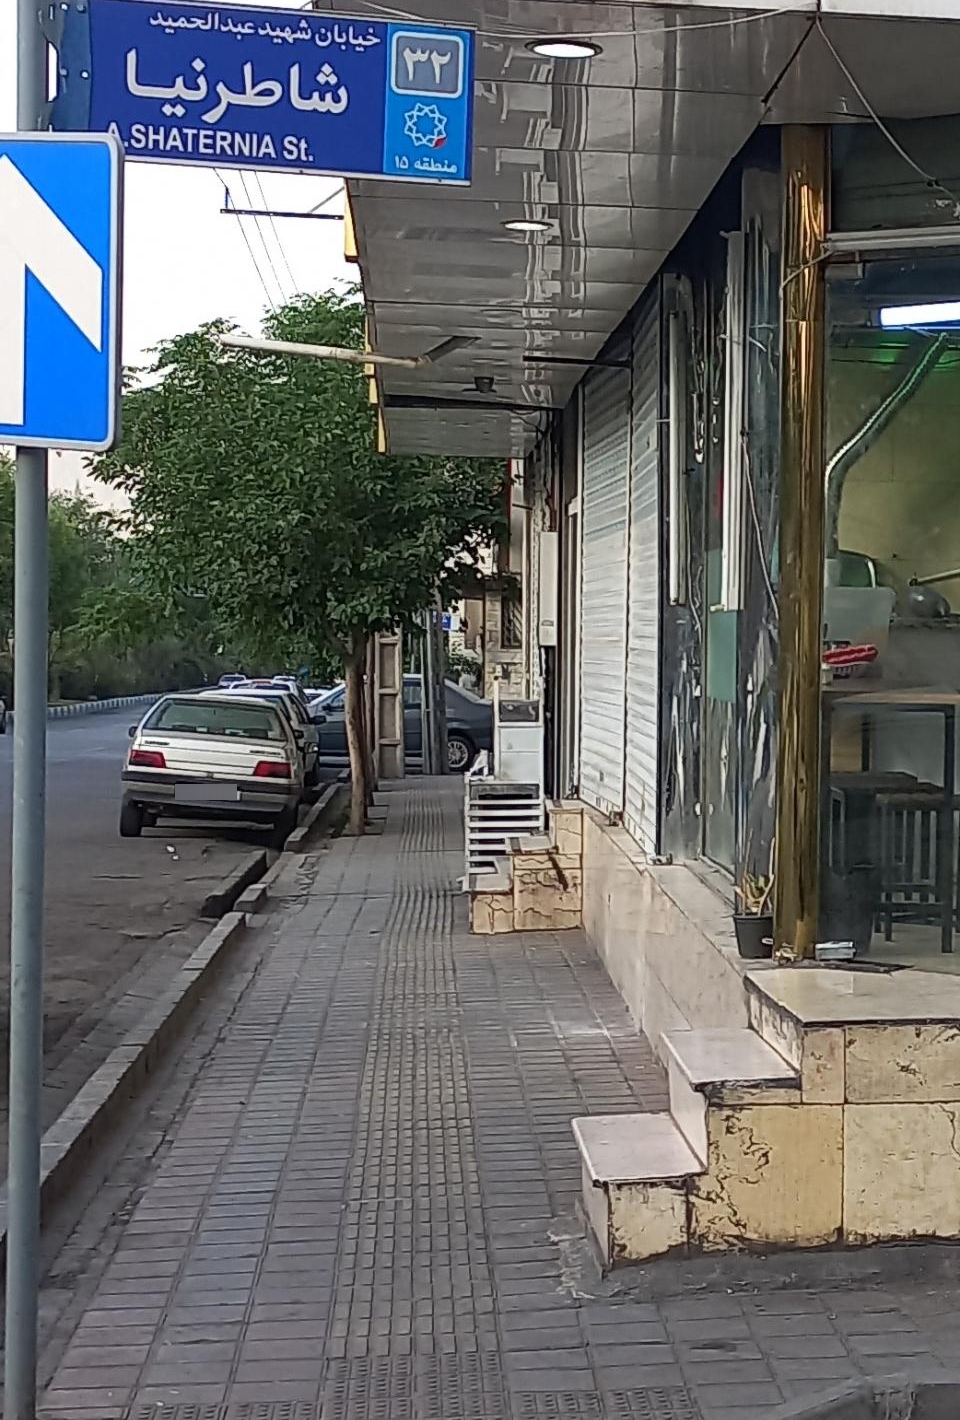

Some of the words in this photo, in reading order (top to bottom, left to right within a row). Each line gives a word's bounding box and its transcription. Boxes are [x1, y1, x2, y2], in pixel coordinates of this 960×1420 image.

[149, 10, 256, 40] عبدالحمید
[257, 18, 313, 44] شهید
[314, 23, 382, 52] خیابان
[402, 46, 451, 85] ۳۲
[125, 47, 349, 125] شاطرنیا
[282, 135, 315, 162] St.
[394, 155, 410, 170] ۱۵
[413, 157, 459, 174] منطقه
